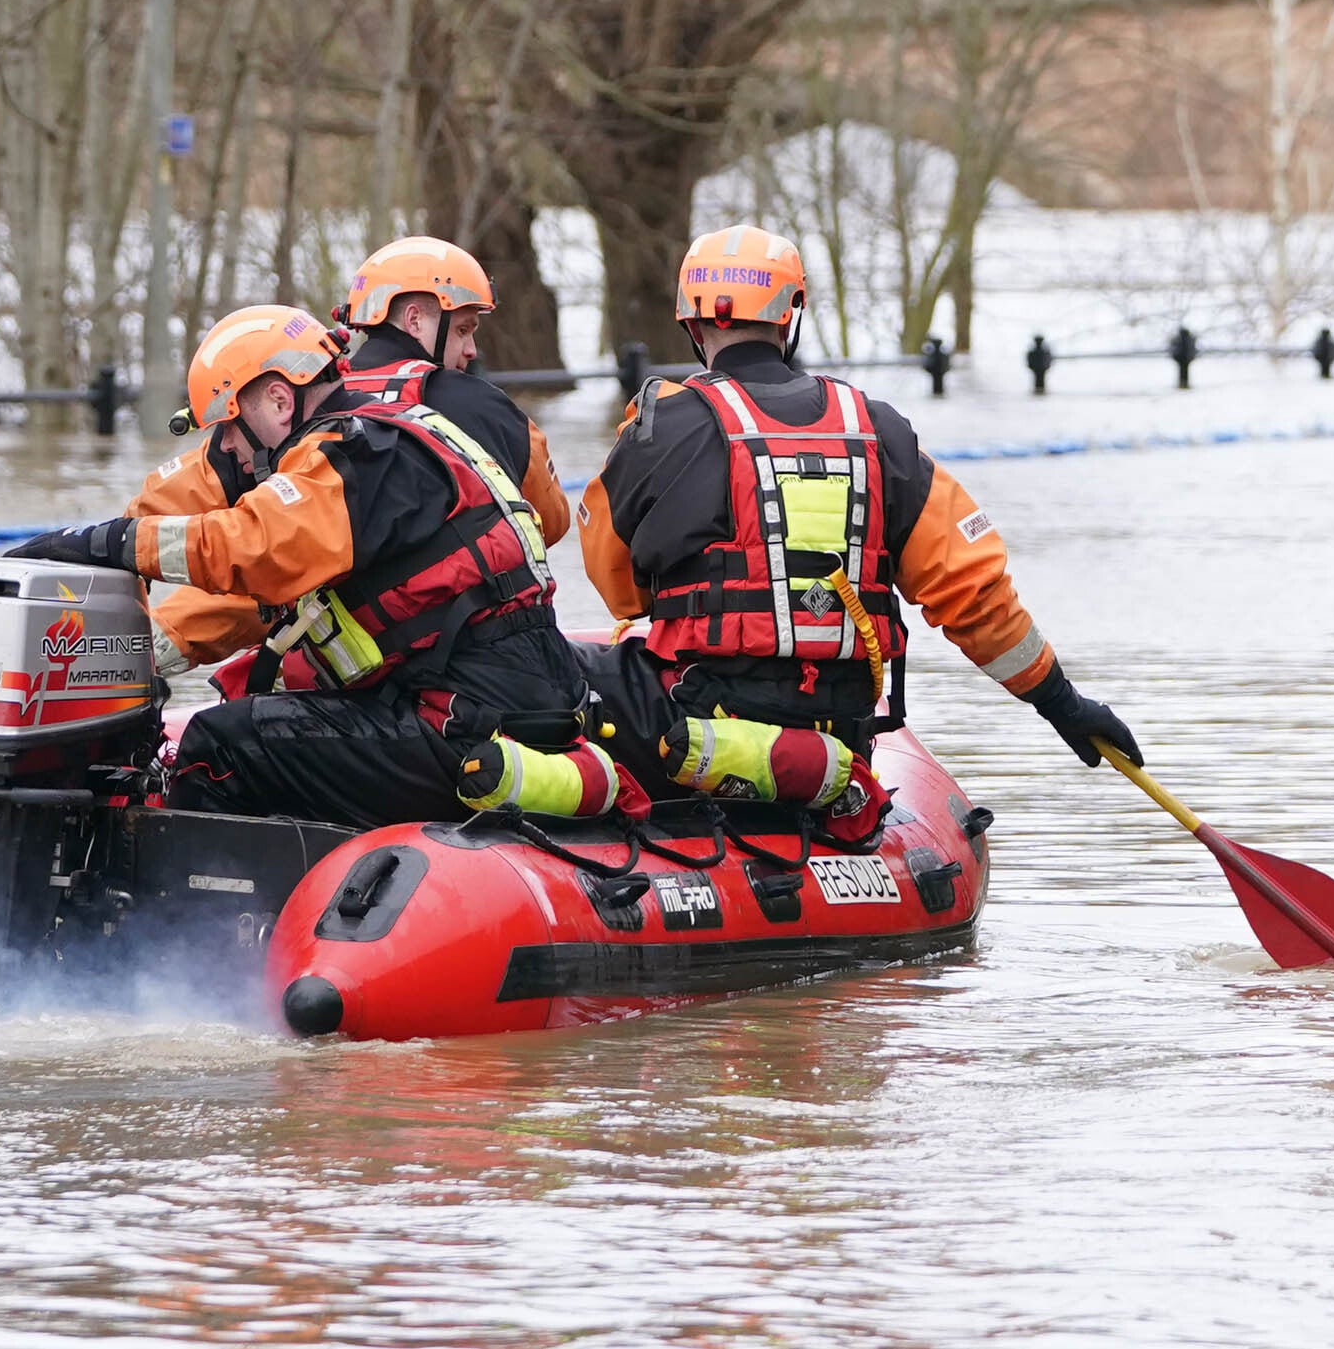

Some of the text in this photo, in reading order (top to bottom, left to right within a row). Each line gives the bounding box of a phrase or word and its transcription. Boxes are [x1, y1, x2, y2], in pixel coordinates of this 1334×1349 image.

[687, 267, 772, 288] FIRE & RESCUE
[68, 669, 137, 683] MARATHON
[811, 854, 898, 900] RESCUE
